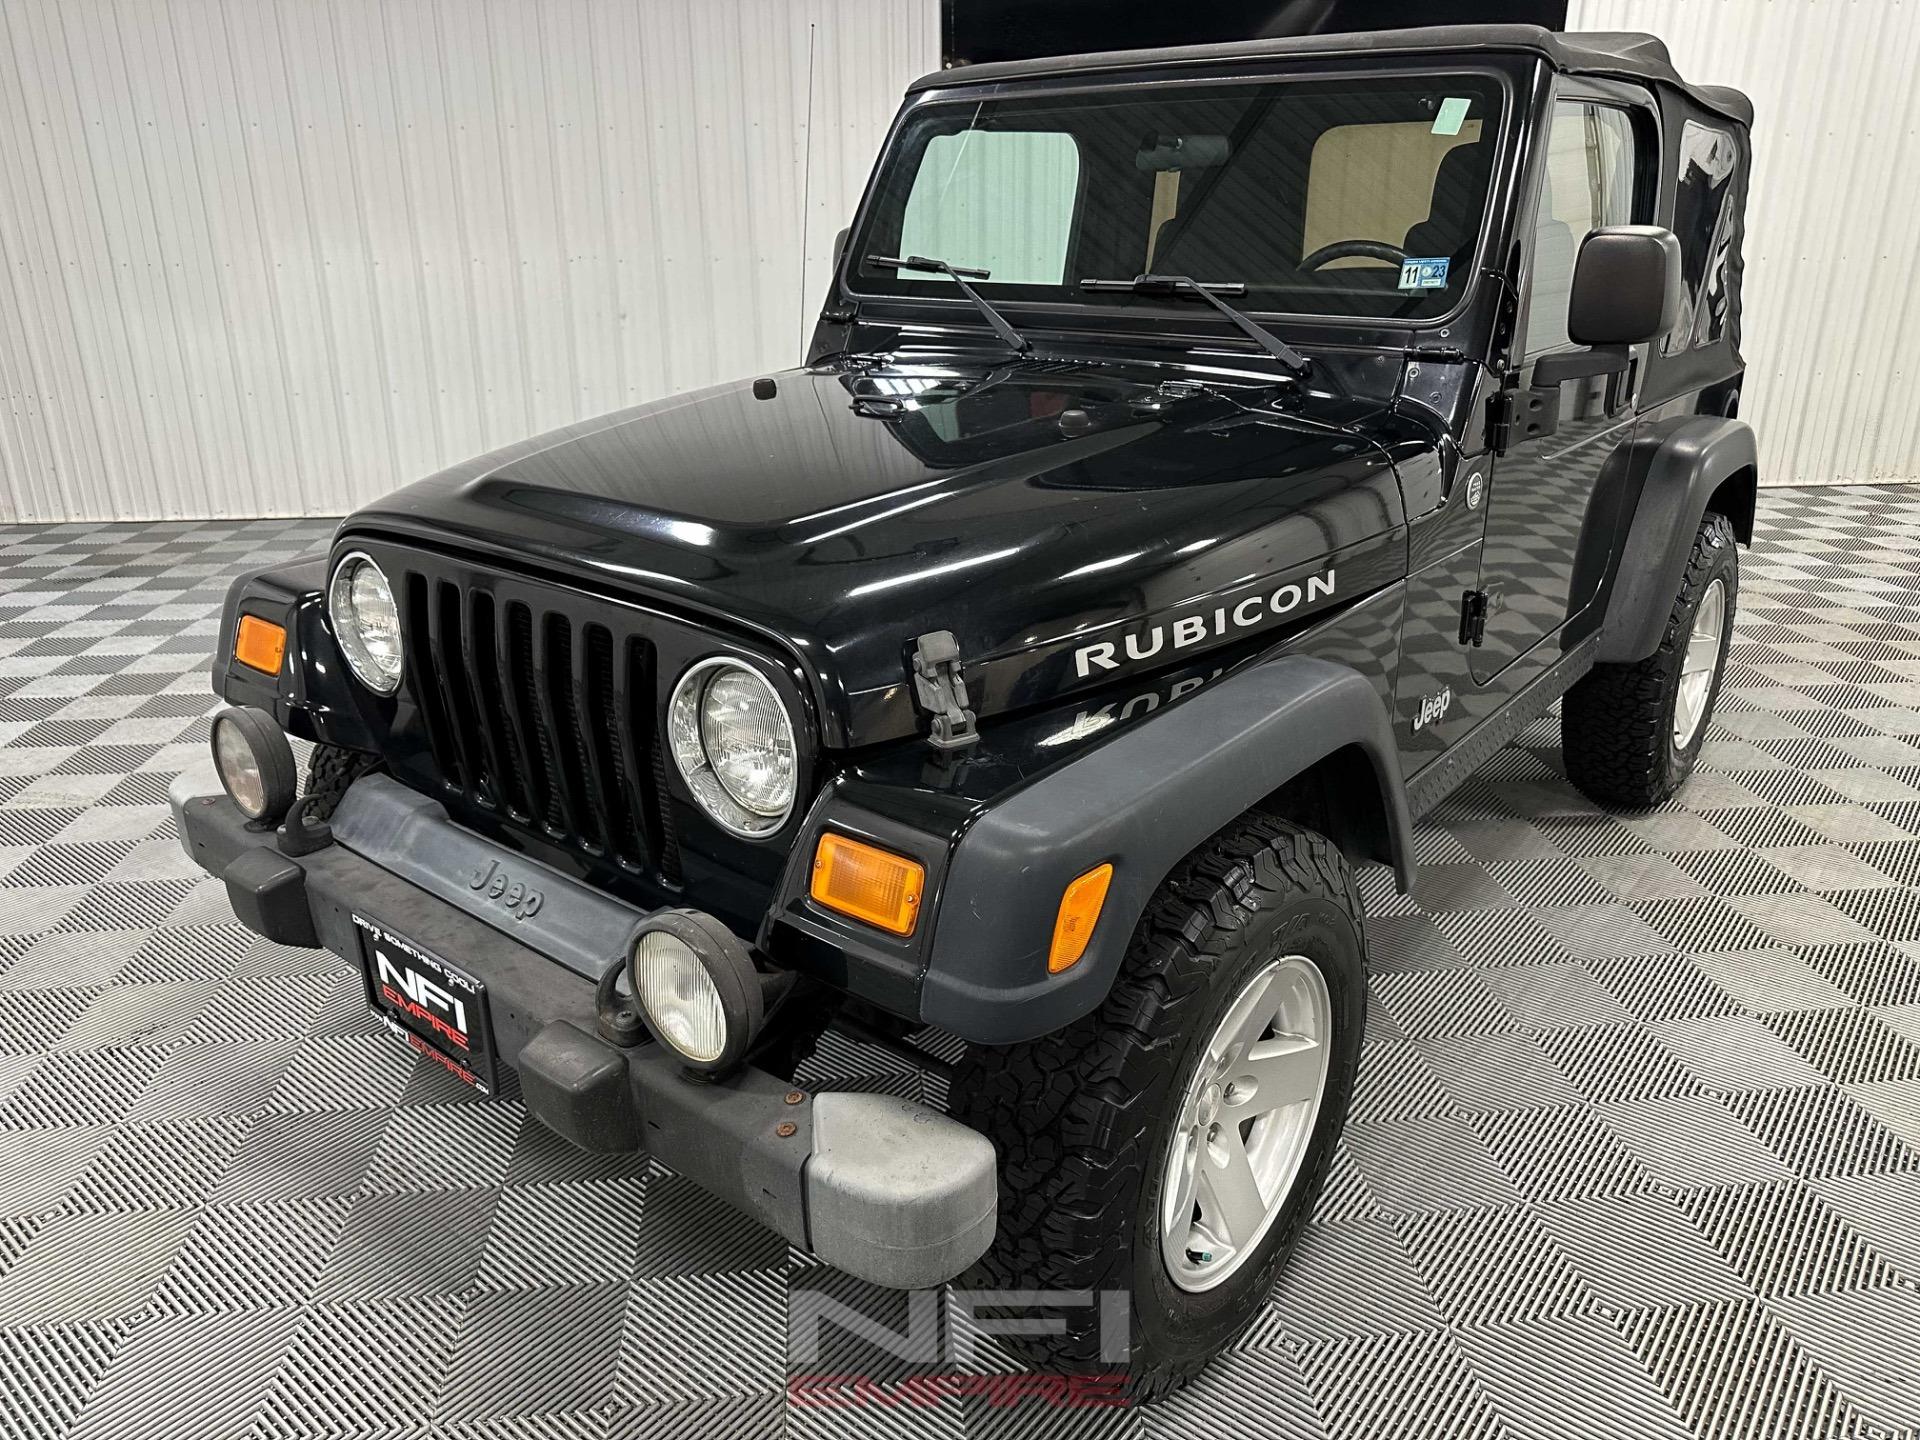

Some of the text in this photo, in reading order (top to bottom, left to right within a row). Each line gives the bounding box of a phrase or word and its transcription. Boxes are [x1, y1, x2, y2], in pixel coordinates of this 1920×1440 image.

[1405, 264, 1446, 283] 11 23
[1075, 569, 1336, 678] RUBICON
[1414, 689, 1450, 730] Jeep
[469, 859, 544, 921] Jeep
[351, 913, 382, 936] DRIVE
[383, 932, 443, 973] SOMETHING
[375, 949, 468, 1034] NFI
[382, 983, 470, 1052] EMPIRE
